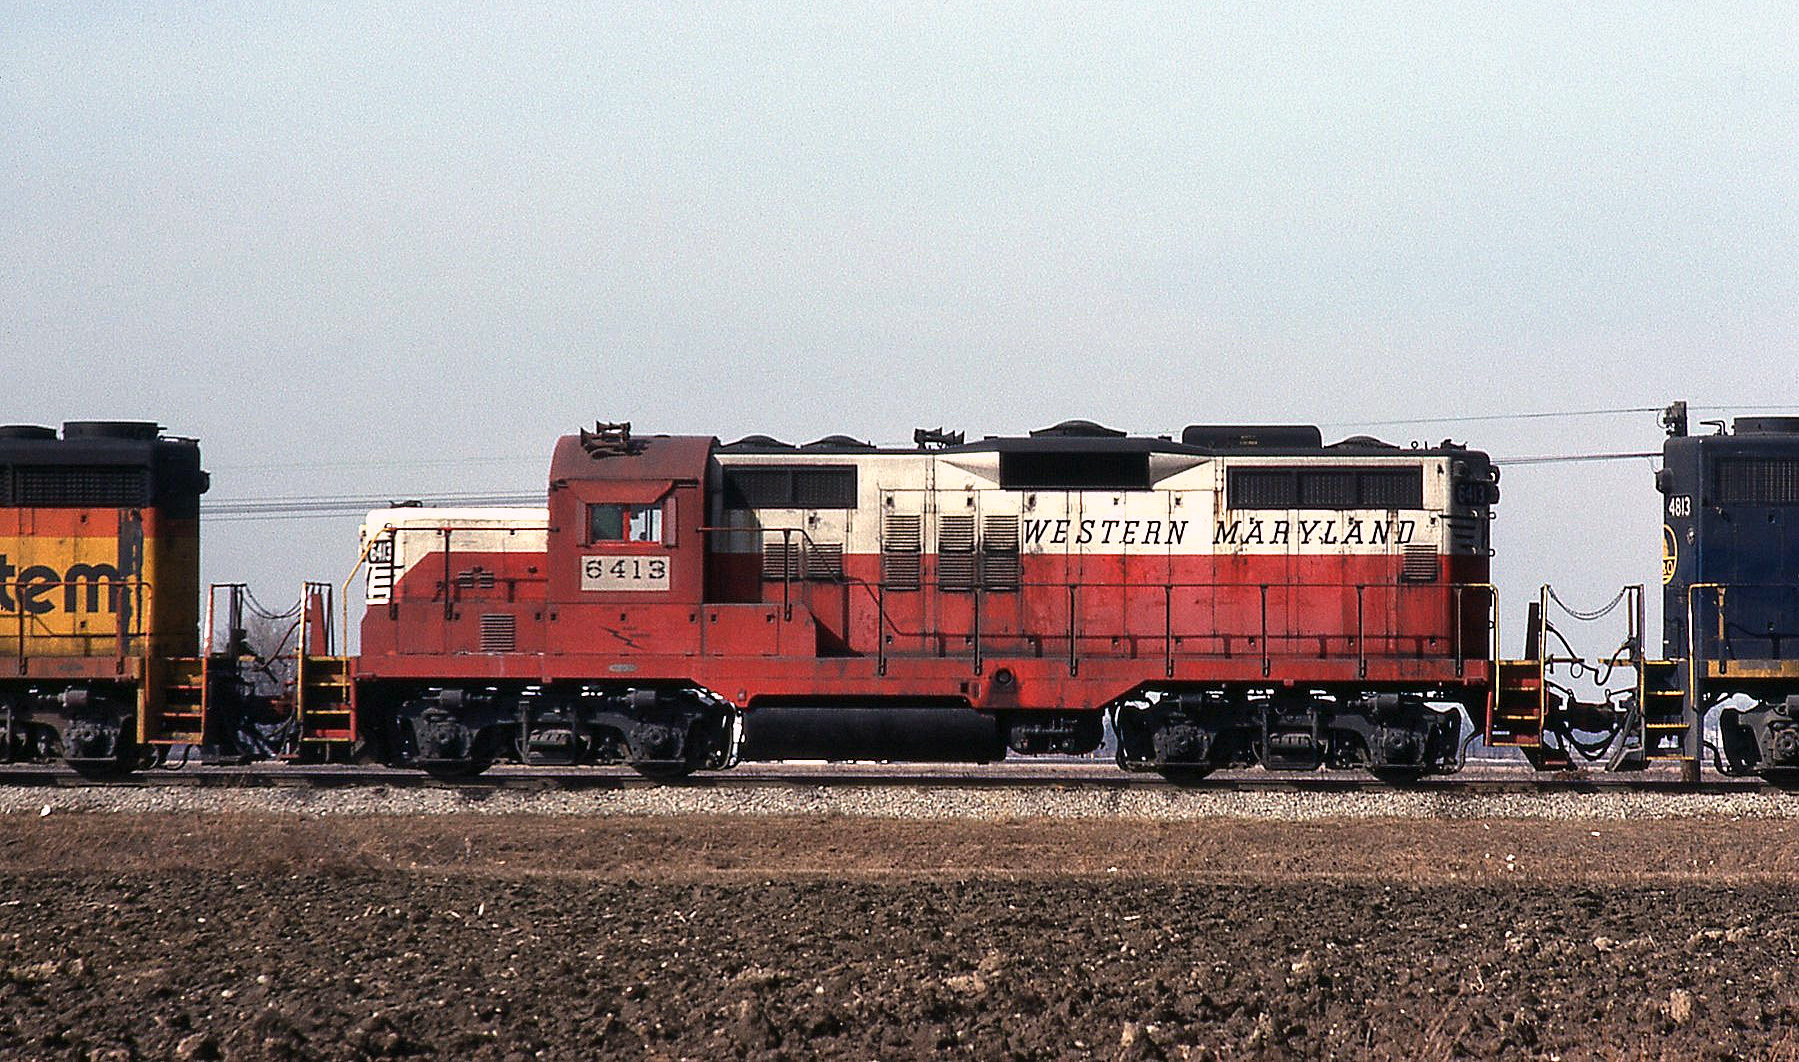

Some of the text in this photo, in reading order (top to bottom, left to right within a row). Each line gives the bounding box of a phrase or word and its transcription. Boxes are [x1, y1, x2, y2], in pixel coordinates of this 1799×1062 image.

[1668, 496, 1691, 517] 4813
[1022, 519, 1417, 546] WESTERN MARYLAND
[586, 559, 665, 579] 6413
